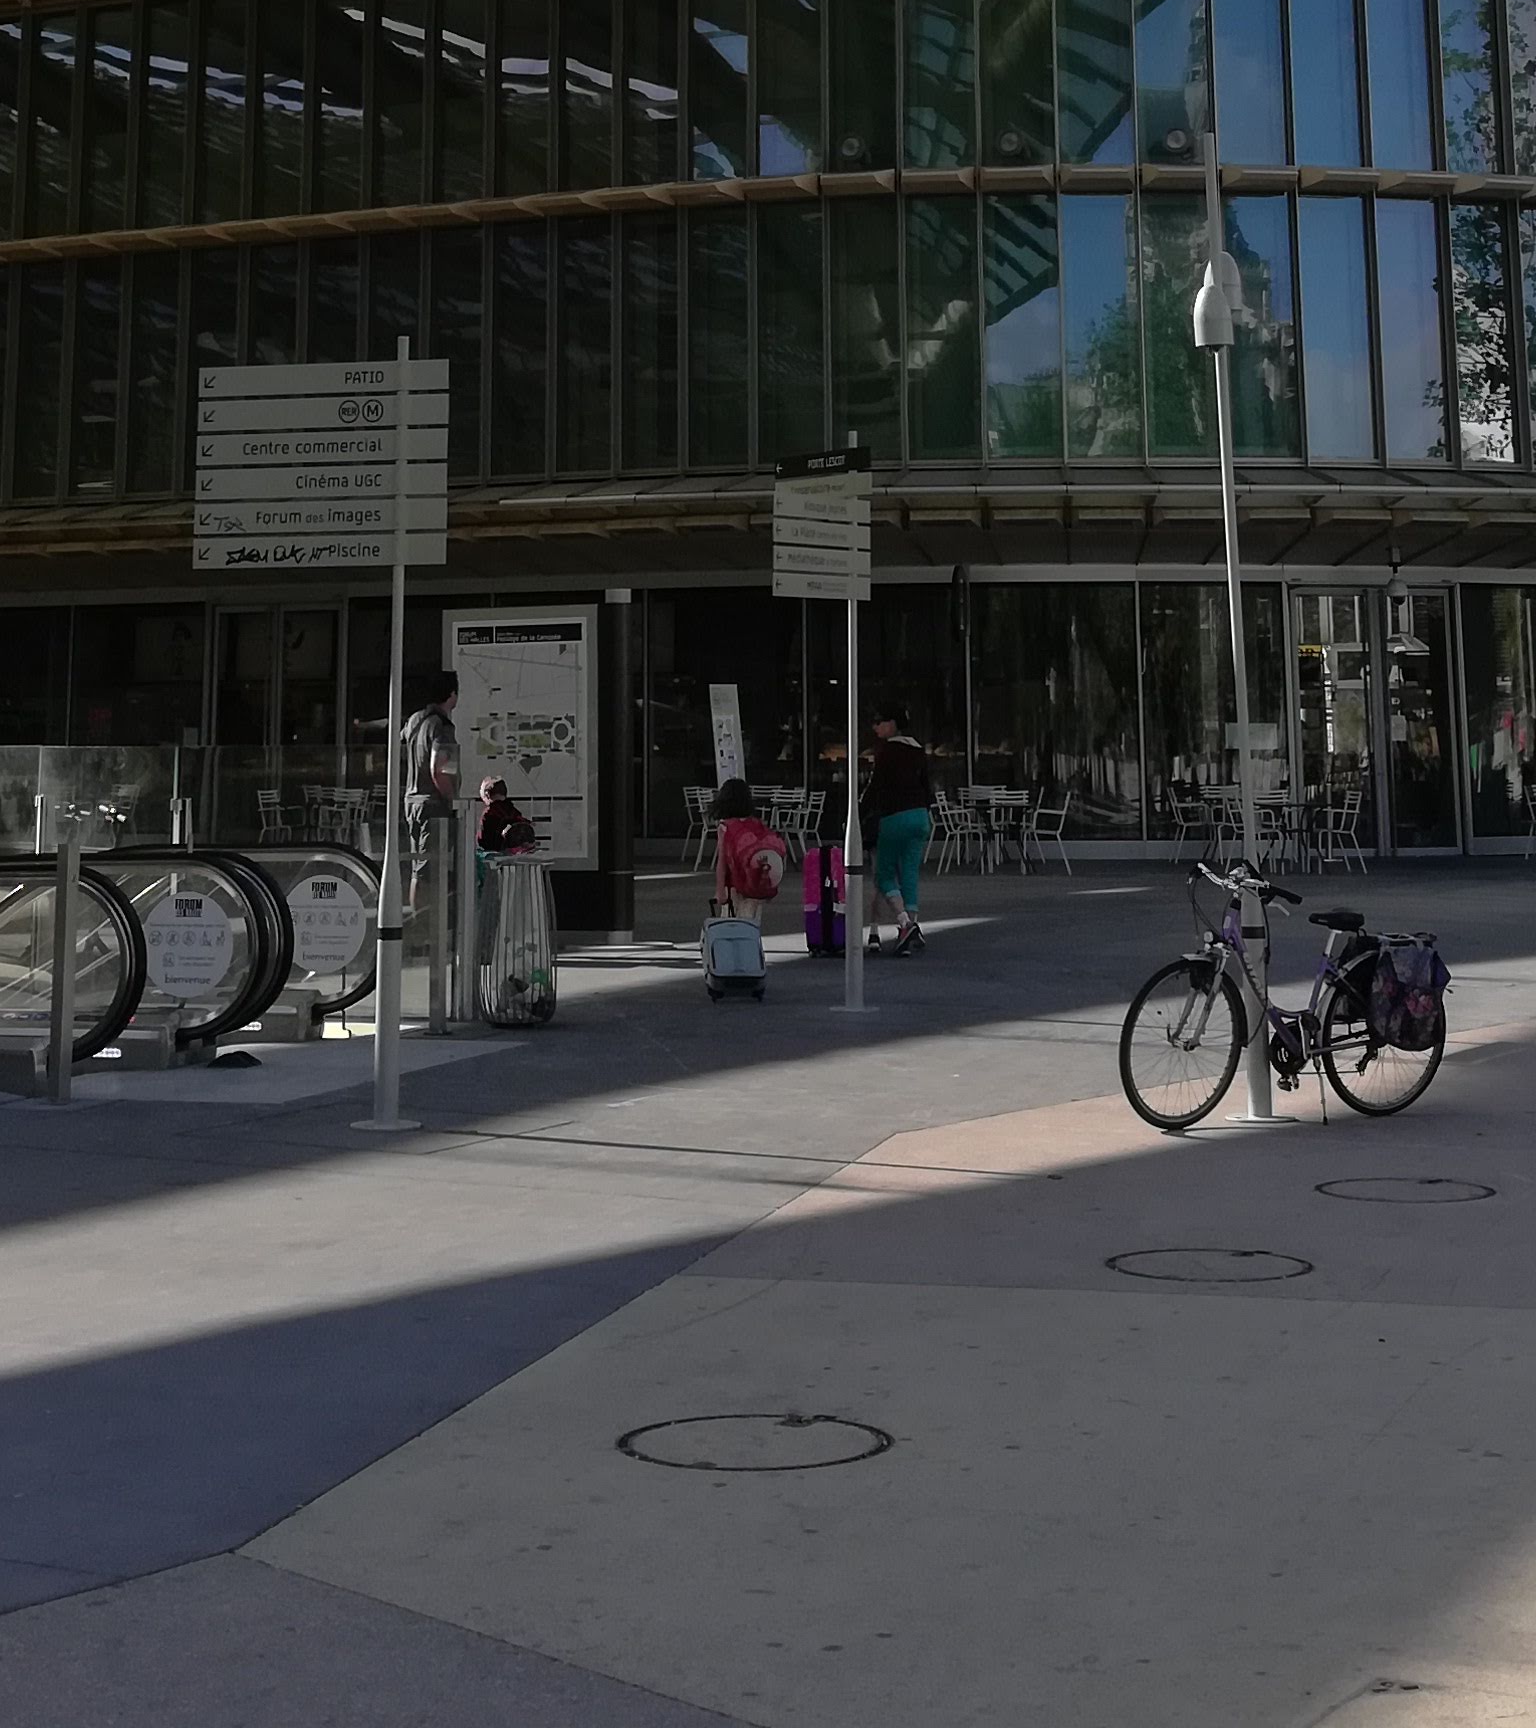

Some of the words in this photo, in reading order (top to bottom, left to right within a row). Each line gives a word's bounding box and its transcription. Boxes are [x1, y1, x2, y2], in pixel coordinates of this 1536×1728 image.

[344, 370, 384, 385] PATIO
[243, 441, 290, 456] Centre
[295, 438, 383, 454] commercial
[296, 474, 349, 489] Cinéma
[354, 473, 383, 487] UGC
[256, 510, 302, 525] Forum
[305, 512, 325, 523] des
[328, 508, 382, 526] images
[328, 542, 381, 558] Piscine
[312, 882, 337, 892] FORUM
[175, 899, 203, 909] FORUM
[164, 973, 211, 985] bienvenue
